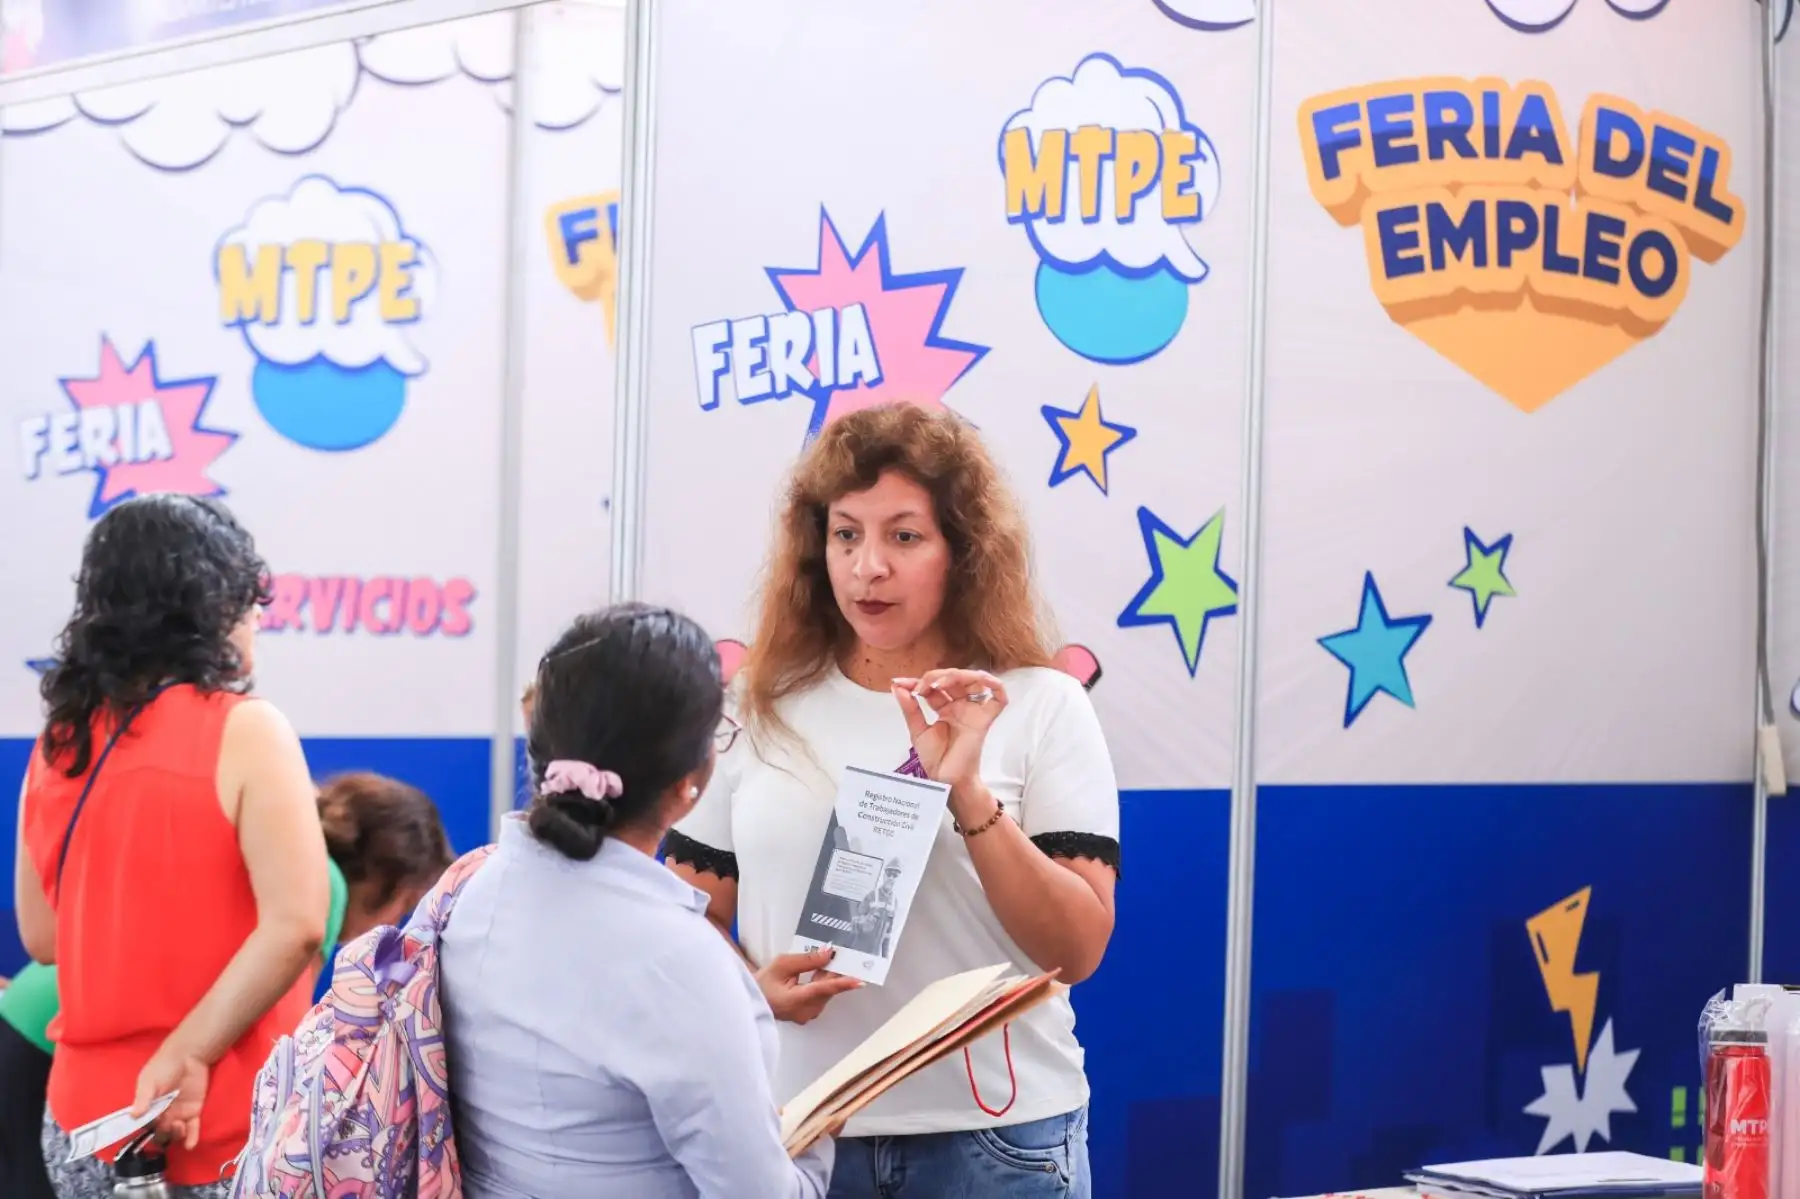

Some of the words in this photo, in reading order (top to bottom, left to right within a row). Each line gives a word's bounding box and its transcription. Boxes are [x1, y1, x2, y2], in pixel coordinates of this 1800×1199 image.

[1004, 124, 1203, 224] MTPE
[1311, 90, 1564, 181] FERIA
[1592, 106, 1735, 226] DEL
[219, 239, 424, 327] MTPE
[1376, 199, 1678, 298] EMPLEO
[691, 302, 884, 412] FERIA
[20, 396, 176, 481] FERIA
